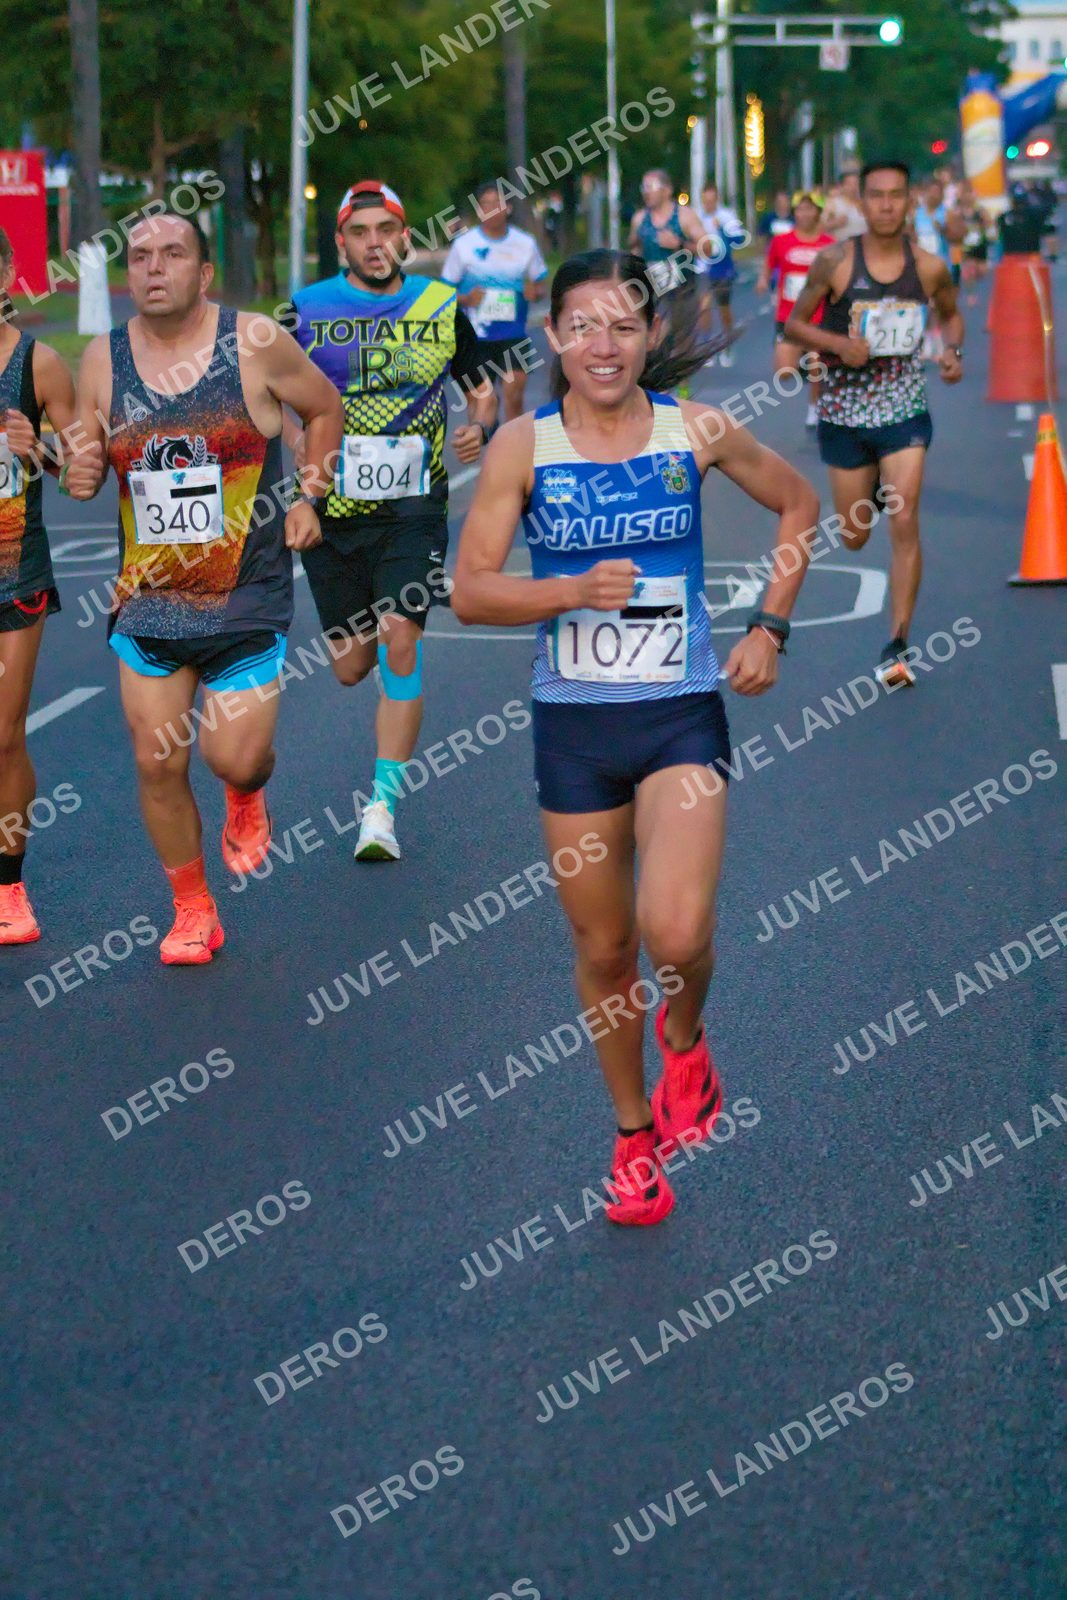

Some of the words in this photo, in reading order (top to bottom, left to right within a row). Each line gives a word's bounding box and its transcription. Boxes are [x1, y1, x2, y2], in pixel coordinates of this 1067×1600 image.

[309, 318, 441, 347] TOTATZI
[875, 328, 914, 349] 215
[357, 463, 411, 491] 804
[146, 500, 211, 535] 340
[544, 504, 693, 551] JALISCO
[566, 621, 683, 668] 1072
